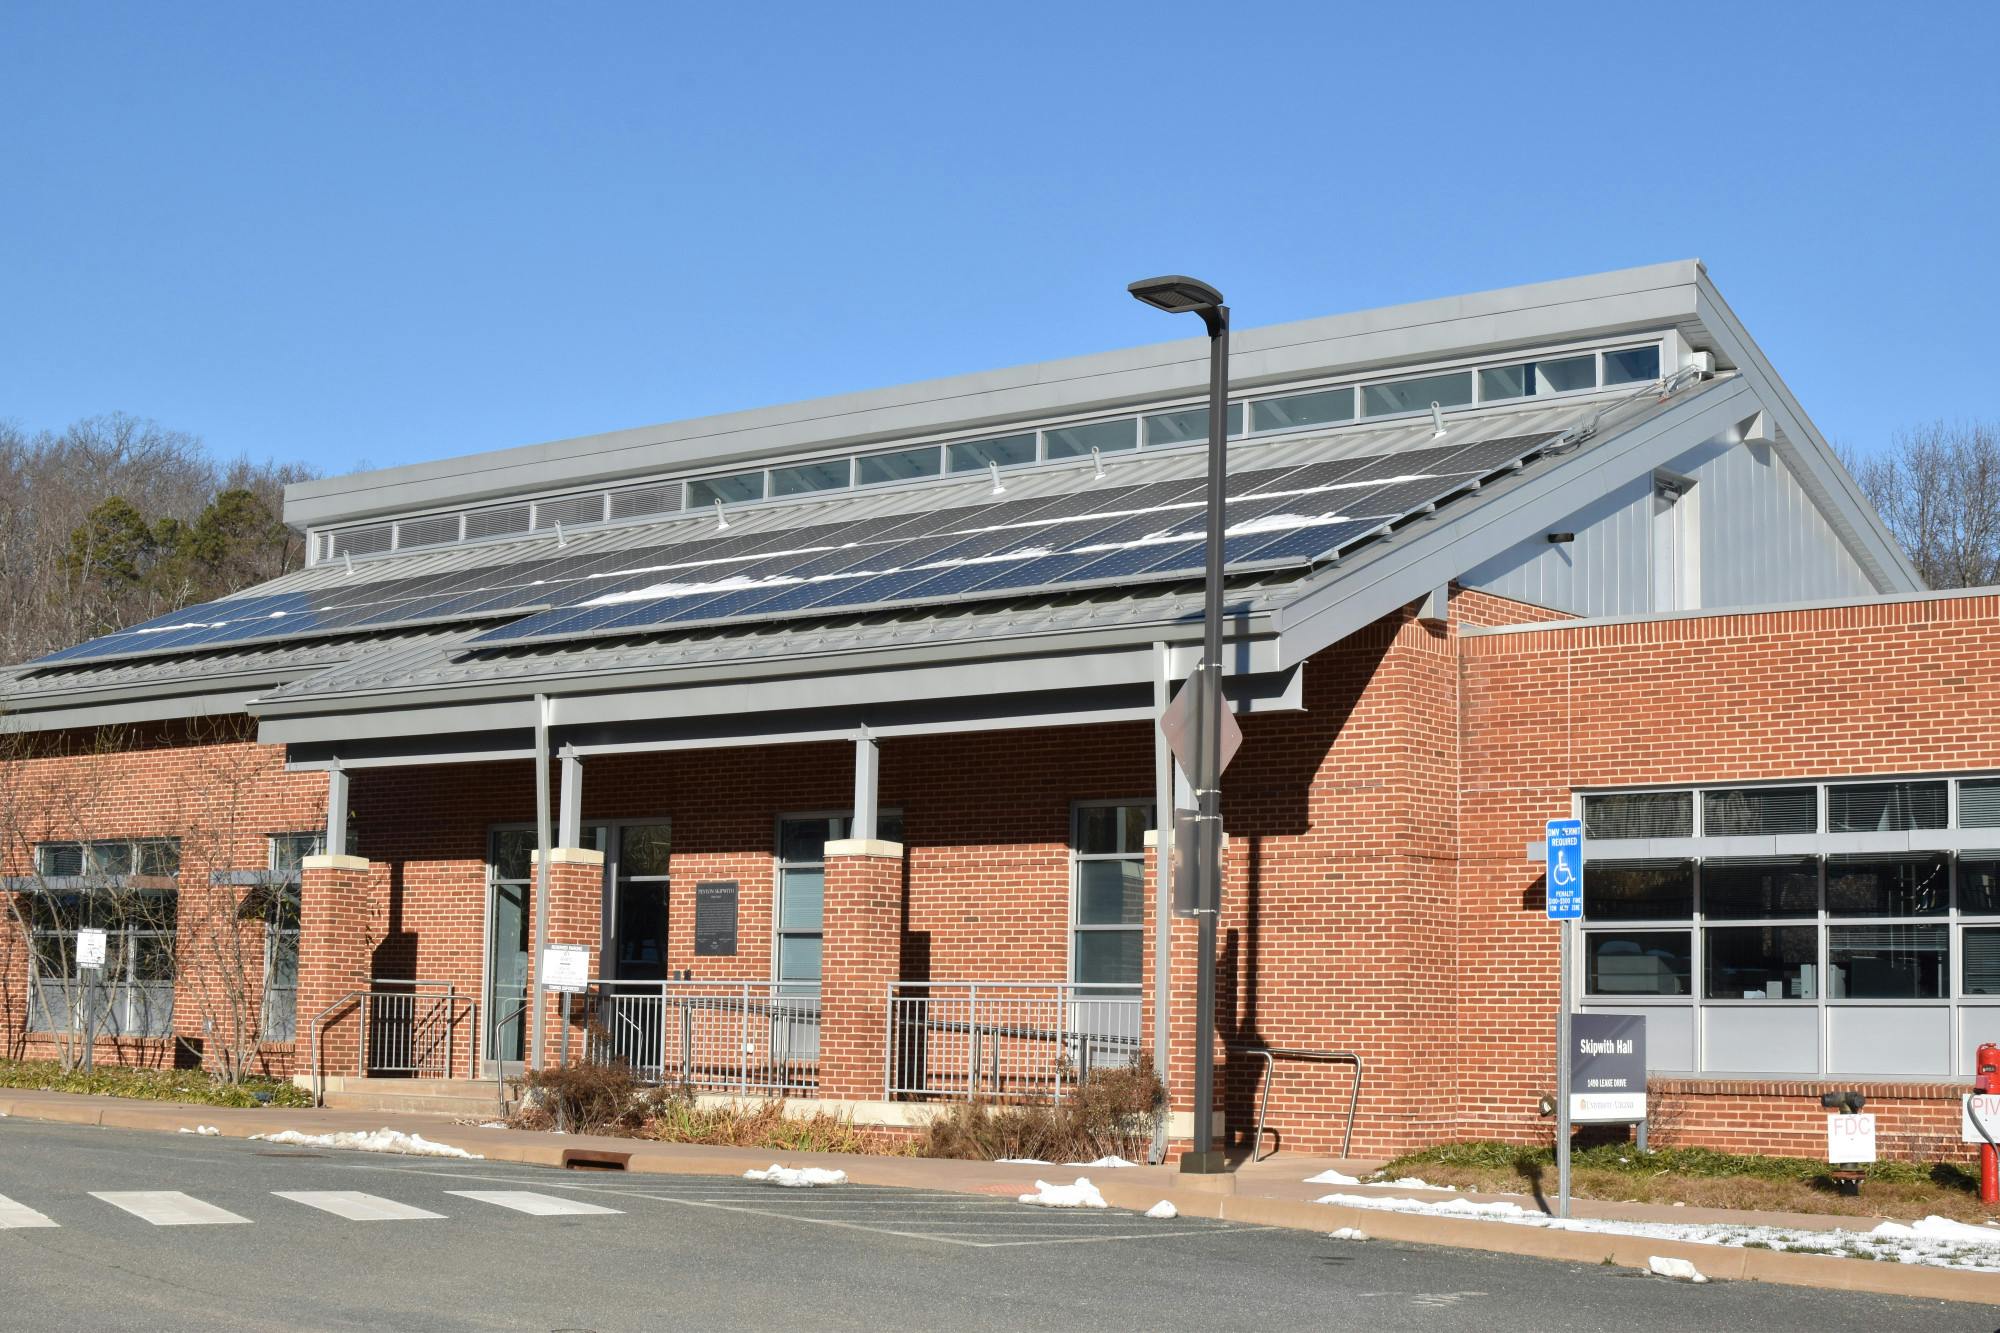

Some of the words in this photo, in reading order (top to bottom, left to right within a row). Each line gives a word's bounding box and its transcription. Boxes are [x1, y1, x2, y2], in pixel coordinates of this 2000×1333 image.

[1551, 837, 1578, 847] REQUIRED
[1580, 1039, 1615, 1056] Skipwith
[1617, 1039, 1632, 1054] Hall
[1834, 1117, 1870, 1136] FDC
